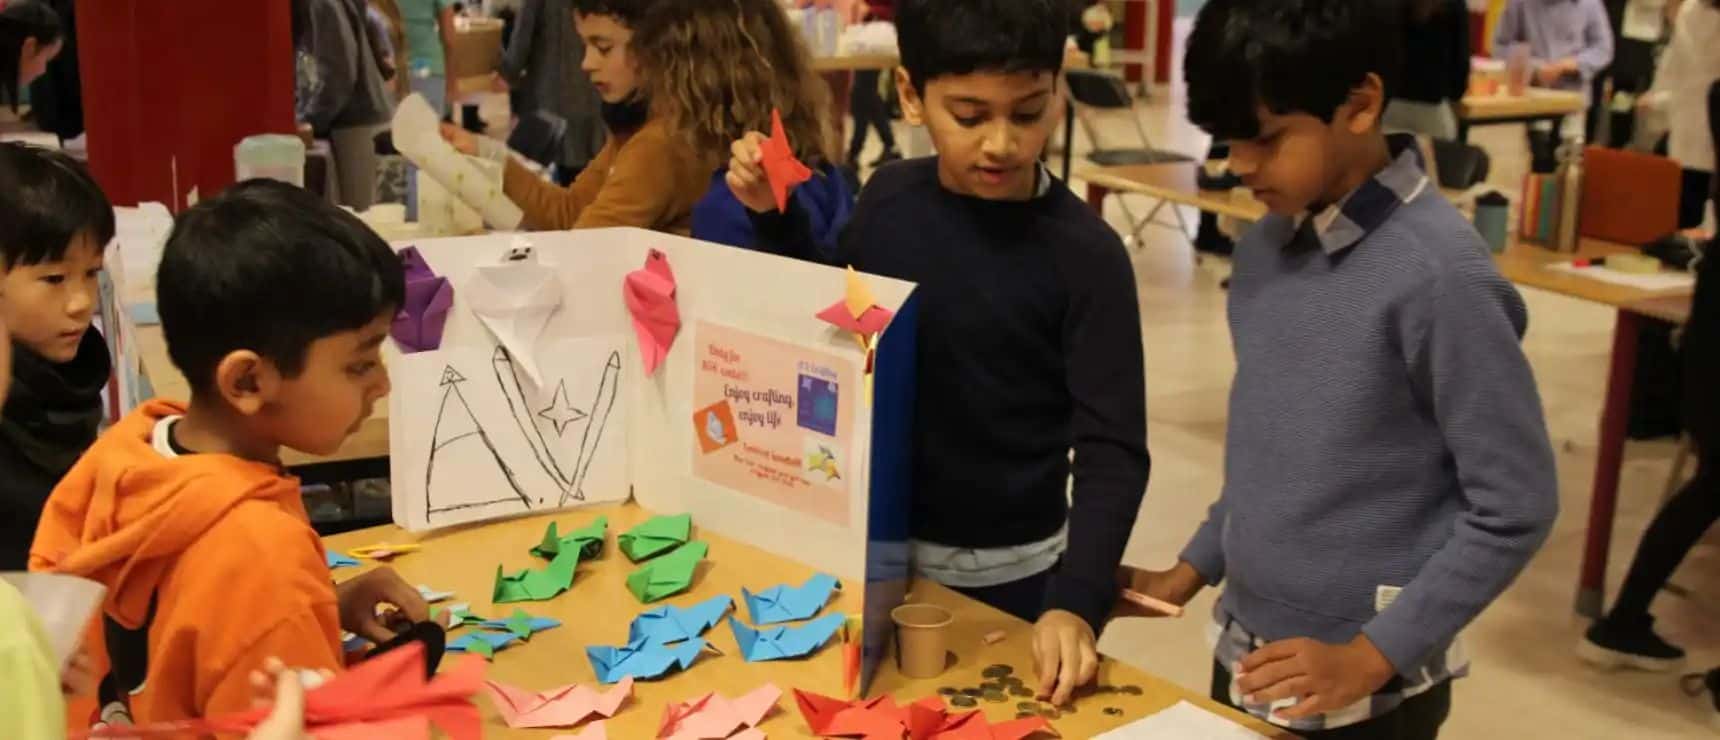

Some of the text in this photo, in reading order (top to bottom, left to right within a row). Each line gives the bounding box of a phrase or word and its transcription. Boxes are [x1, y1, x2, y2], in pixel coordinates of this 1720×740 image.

[723, 383, 750, 404] Enjoy
[738, 409, 782, 430] enjoy life
